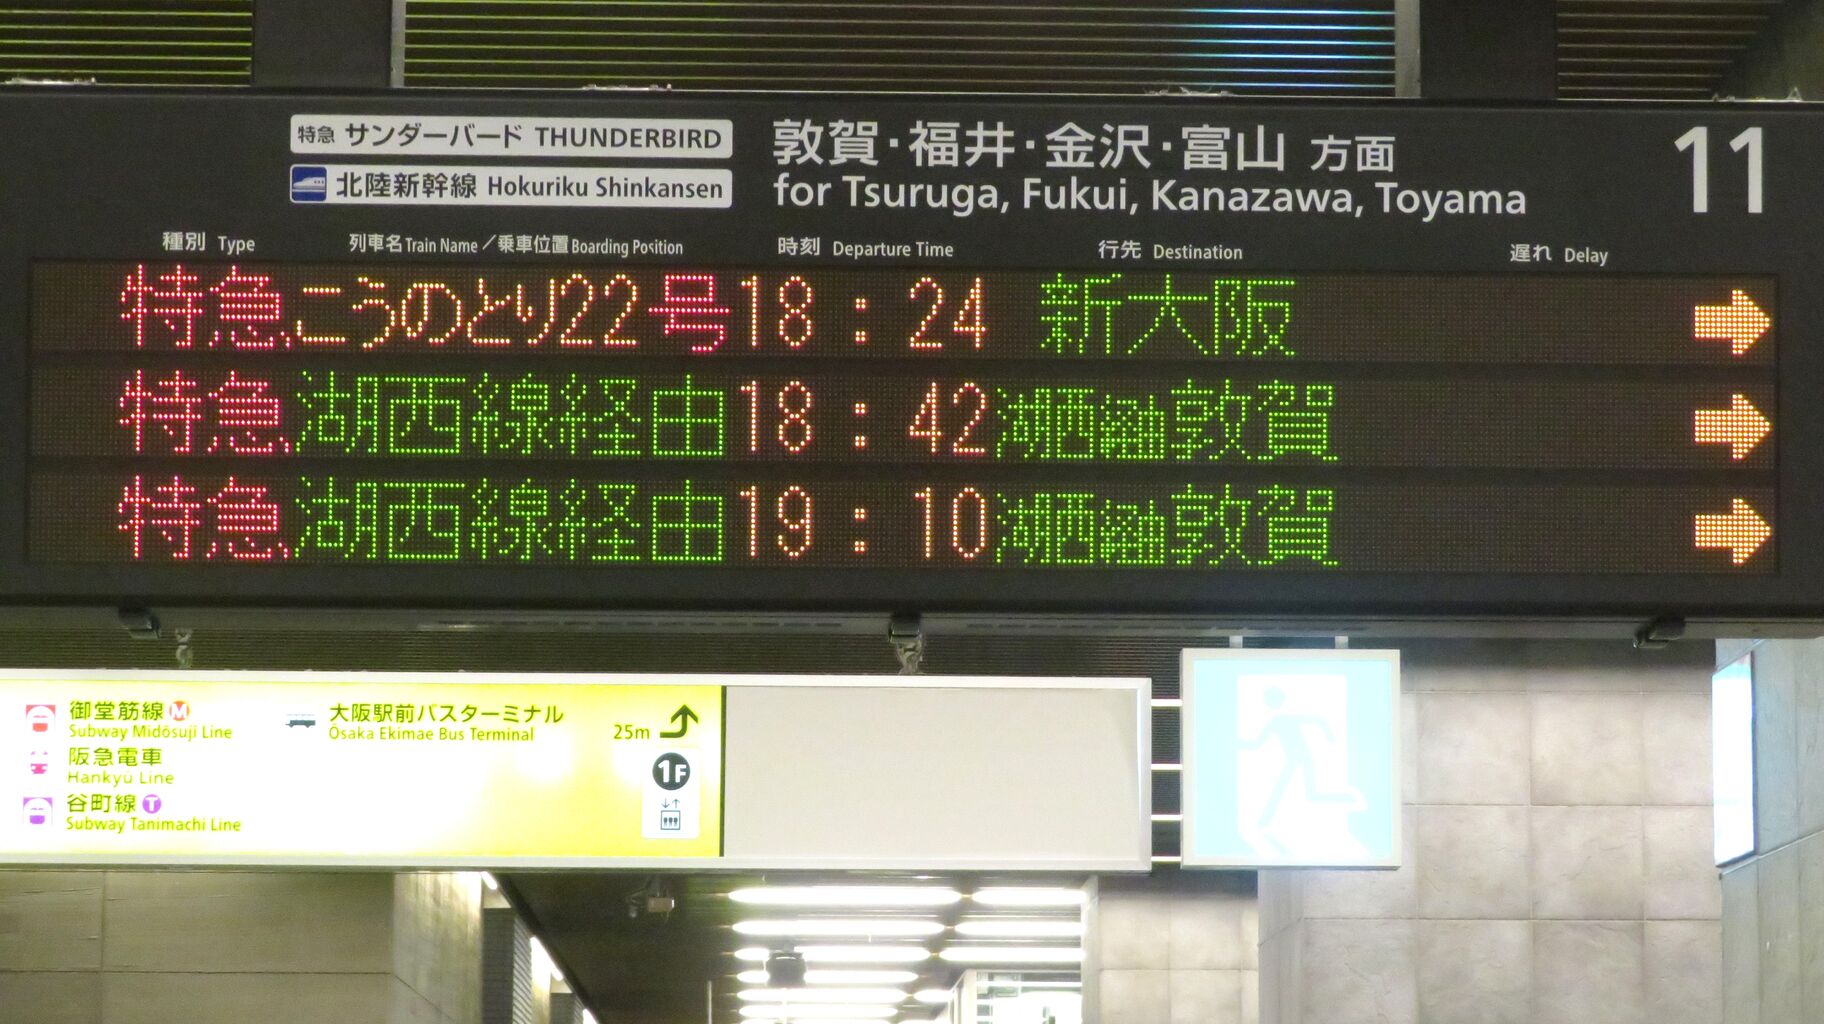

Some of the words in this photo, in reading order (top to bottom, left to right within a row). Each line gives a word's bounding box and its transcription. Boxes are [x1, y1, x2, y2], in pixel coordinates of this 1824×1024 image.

[298, 125, 335, 144] 特急
[345, 123, 522, 149] サンダーバード
[535, 127, 722, 149] THUNDERBIRD
[1310, 134, 1396, 172] 方面
[1674, 126, 1763, 214] 11
[336, 171, 477, 199] 北陸新幹線
[488, 175, 588, 197] Hokuriku
[596, 177, 723, 199] Shinkansen
[773, 172, 832, 207] for
[842, 175, 1009, 217] Tsuruga,
[1023, 176, 1138, 216] Fukui,
[1152, 179, 1364, 218] Kanazawa,
[1375, 182, 1526, 221] Toyama
[162, 231, 206, 251] 種別
[218, 235, 256, 255] Type
[349, 233, 402, 253] 列車名
[405, 237, 436, 253] Train
[440, 238, 478, 254] Name
[572, 238, 629, 258] Boarding
[633, 239, 683, 255] Position
[778, 237, 820, 256] 時刻
[833, 241, 911, 260] Departure
[916, 241, 954, 257] Time
[1098, 240, 1141, 259] 行先
[1153, 244, 1243, 260] Destination
[1510, 244, 1552, 262] 遅れ
[1564, 247, 1608, 267] Delay
[1040, 272, 1297, 356] 新大阪
[69, 701, 164, 720] 御堂筋線
[170, 702, 190, 720] M
[329, 703, 565, 723] 大阪駅前バスターミナル
[69, 724, 128, 741] Subway
[202, 725, 233, 738] Line
[380, 727, 434, 741] Ekimae
[439, 728, 464, 741] Bus
[471, 728, 535, 741] Terminal
[613, 724, 650, 739] 25m
[69, 747, 162, 766] 阪急電車
[140, 771, 174, 784] Line
[658, 760, 687, 783] 1F
[67, 794, 136, 813] 谷町線
[66, 817, 125, 833] Subway
[132, 817, 206, 831] Tanimachi
[211, 818, 241, 831] Line
